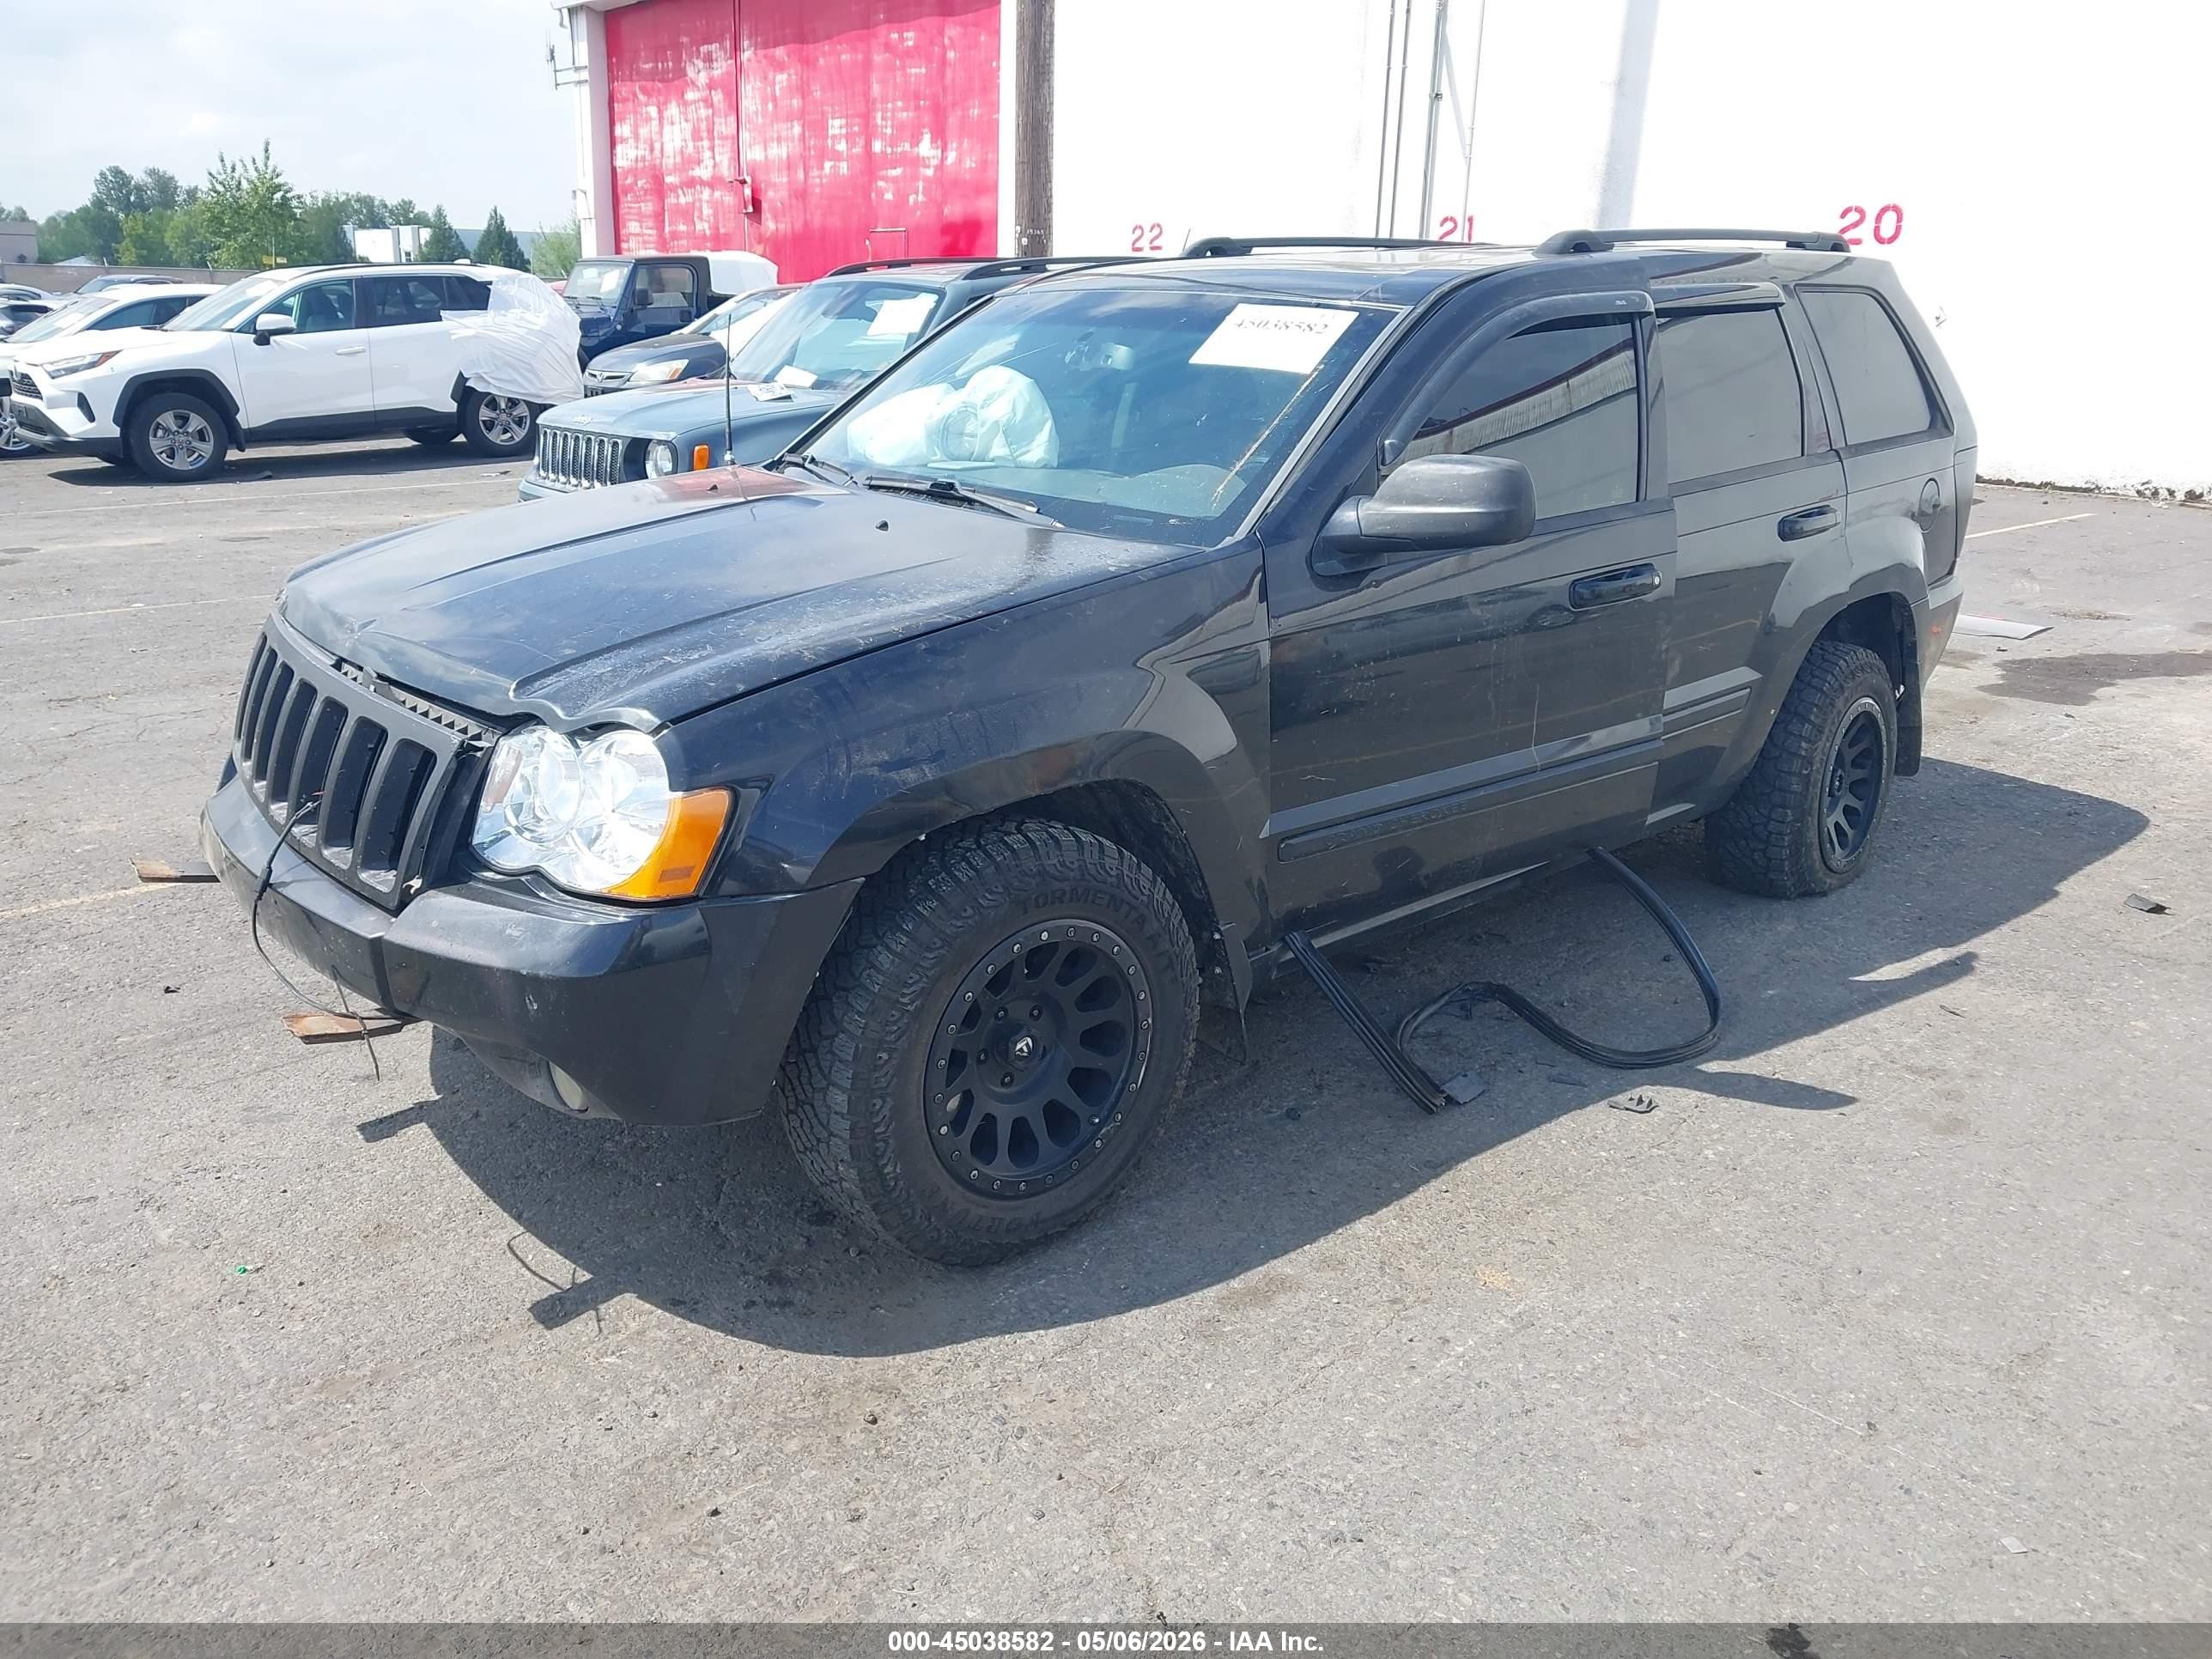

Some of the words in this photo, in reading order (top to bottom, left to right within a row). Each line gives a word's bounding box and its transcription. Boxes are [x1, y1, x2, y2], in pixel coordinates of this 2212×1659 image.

[1132, 222, 1164, 252] 22
[1438, 215, 1474, 243] 21
[1838, 204, 1904, 246] 20
[1015, 886, 1149, 931] TORMENTA
